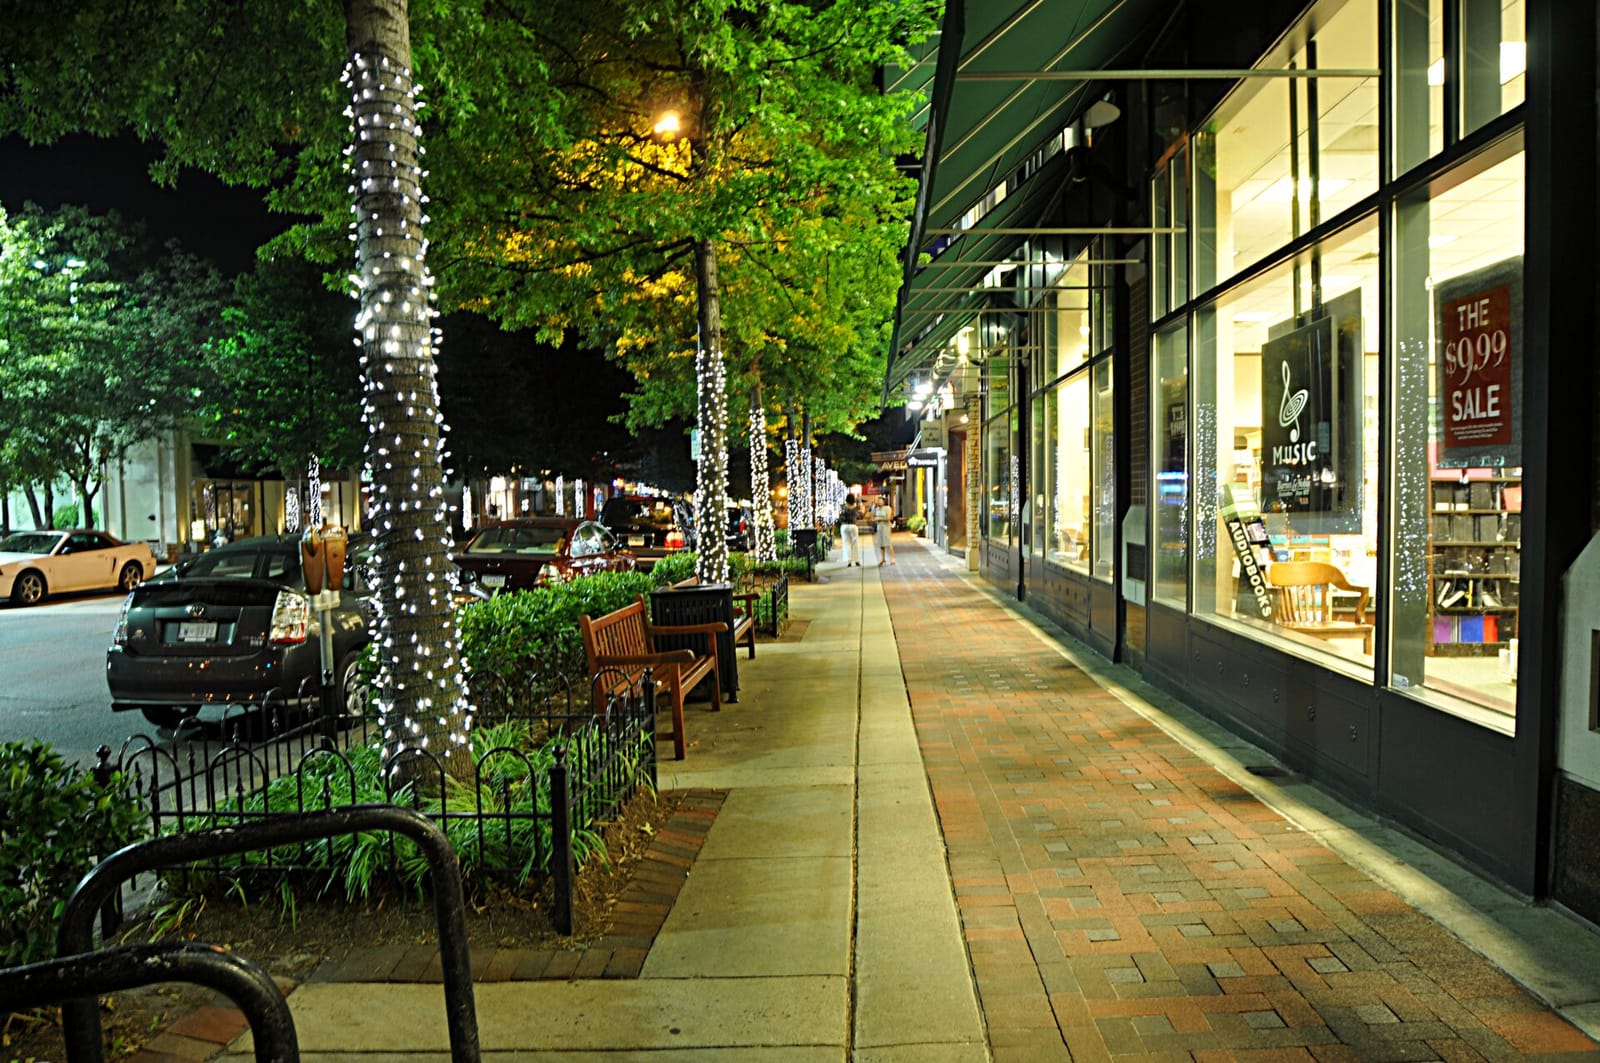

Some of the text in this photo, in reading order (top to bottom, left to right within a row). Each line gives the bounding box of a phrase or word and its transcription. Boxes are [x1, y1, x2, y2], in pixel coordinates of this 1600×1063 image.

[1457, 298, 1490, 332] THE
[1445, 329, 1507, 386] $9.99
[1452, 384, 1501, 422] SALE
[1272, 440, 1317, 466] MUSIC
[1229, 521, 1272, 618] AUDIOBOOKS
